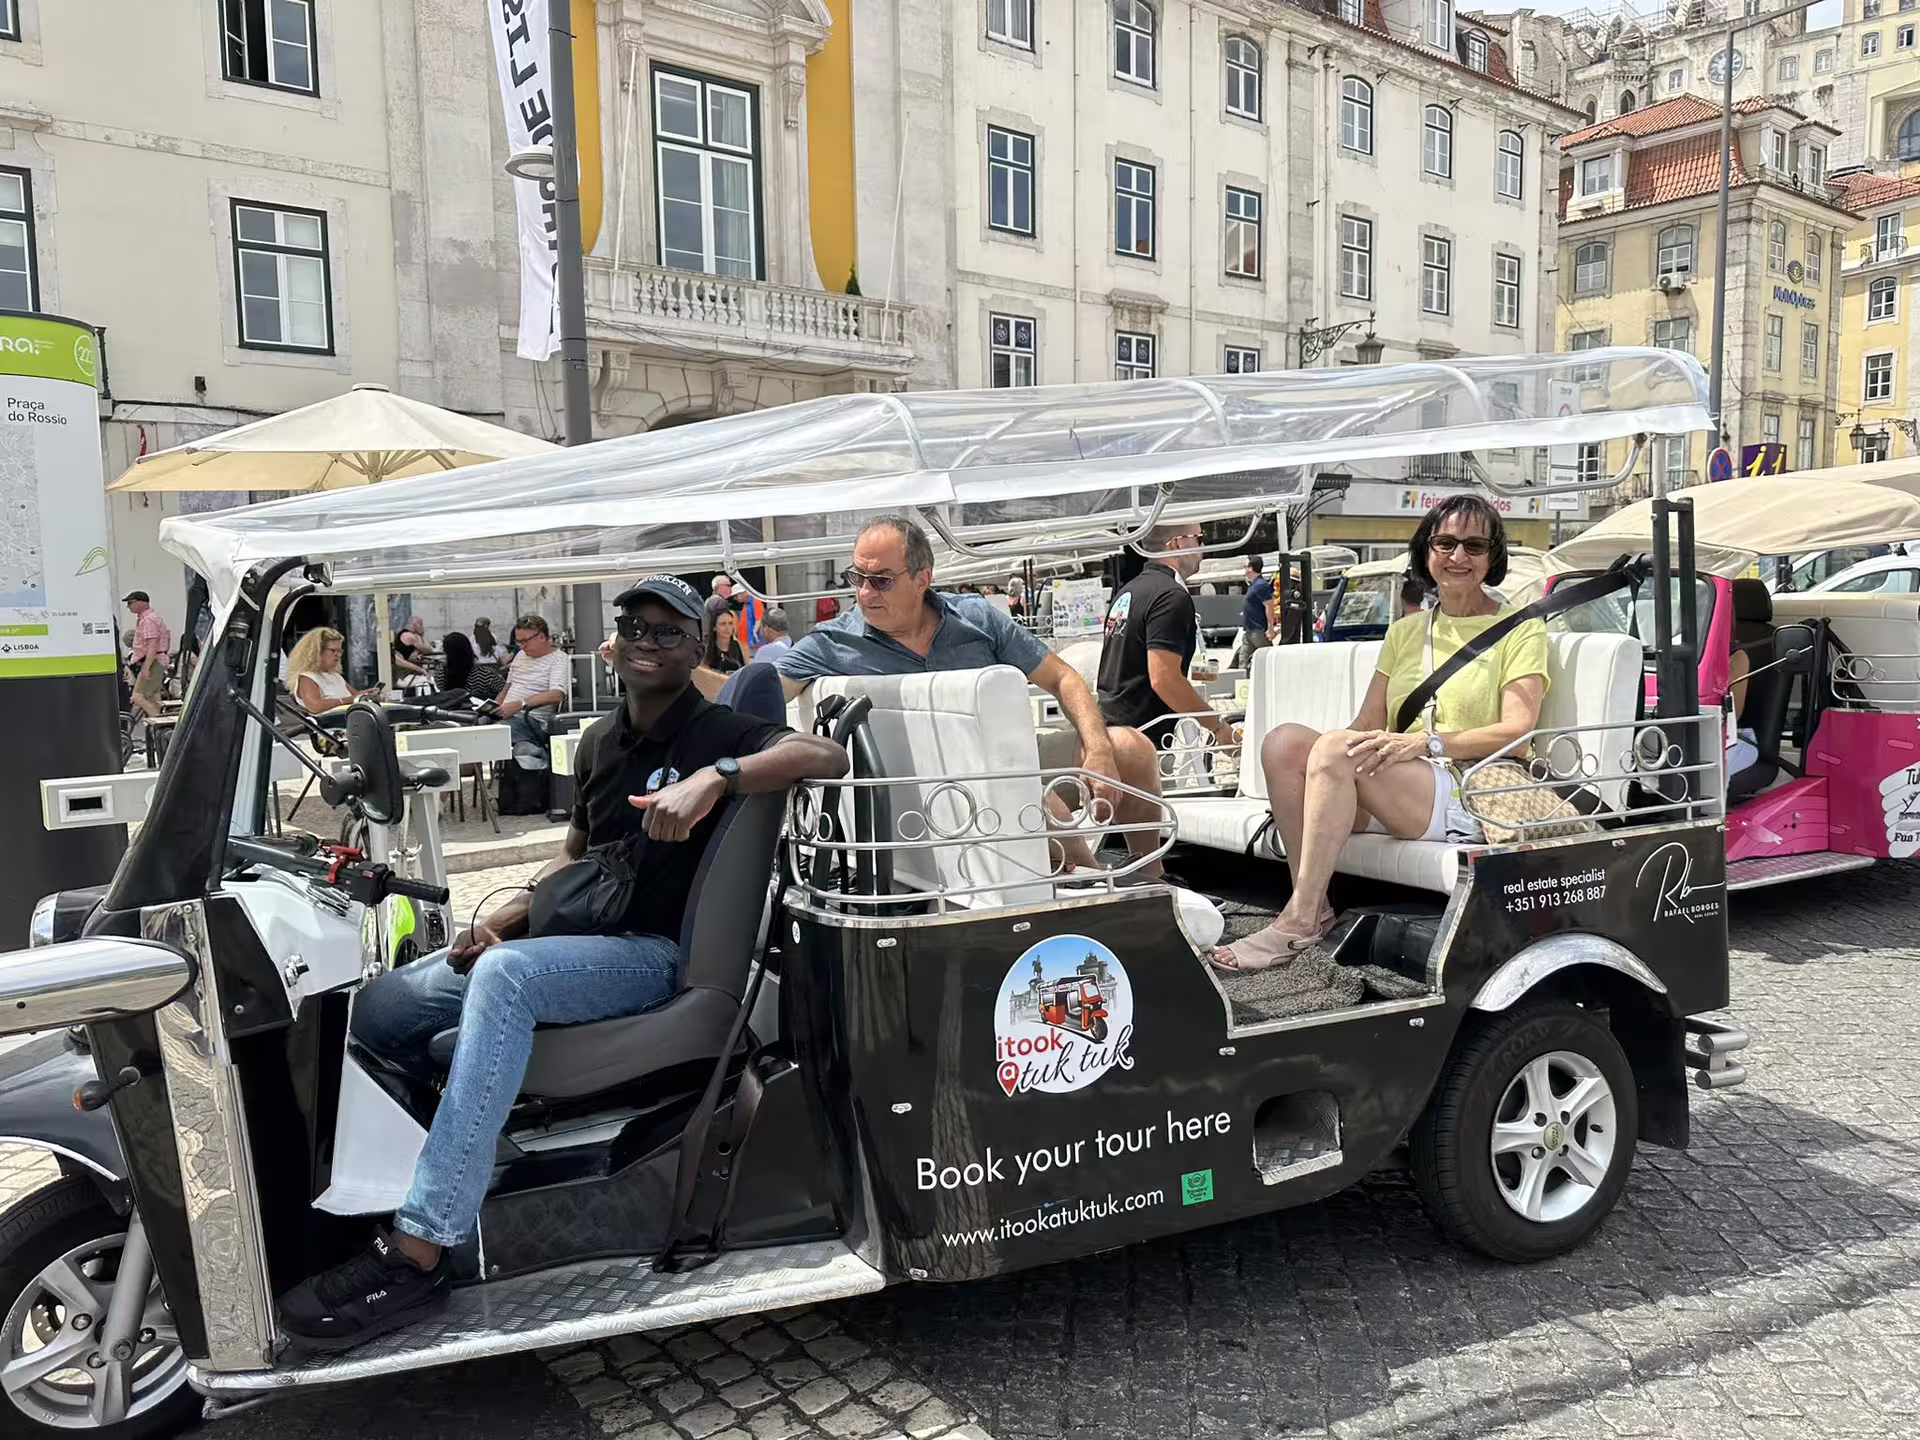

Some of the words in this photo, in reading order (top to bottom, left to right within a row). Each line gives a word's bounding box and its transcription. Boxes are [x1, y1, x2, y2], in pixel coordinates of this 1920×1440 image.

[7, 397, 45, 411] Praça
[8, 411, 25, 422] do
[28, 411, 67, 425] Rossio
[1226, 529, 1267, 538] PRAAS
[13, 643, 39, 651] LISBOA
[1894, 832, 1914, 843] Fun
[1503, 878, 1525, 895] real
[1527, 873, 1558, 890] estate
[1560, 868, 1606, 889] specialist
[1505, 897, 1535, 913] +351
[1538, 893, 1561, 909] 913
[1564, 889, 1584, 905] 268
[1586, 885, 1607, 901] 887
[1664, 907, 1690, 918] RAFAEL
[1690, 902, 1719, 913] BORGES
[1020, 1041, 1075, 1090] tuk
[1079, 1025, 1133, 1072] tuk
[916, 1147, 1006, 1191] Book
[1014, 1138, 1086, 1186] your
[1094, 1124, 1156, 1159] tour
[1166, 1110, 1232, 1144] here
[942, 1188, 1165, 1248] www.itookatuktuk.com
[374, 1237, 388, 1255] FILA
[366, 1290, 387, 1303] FILA
